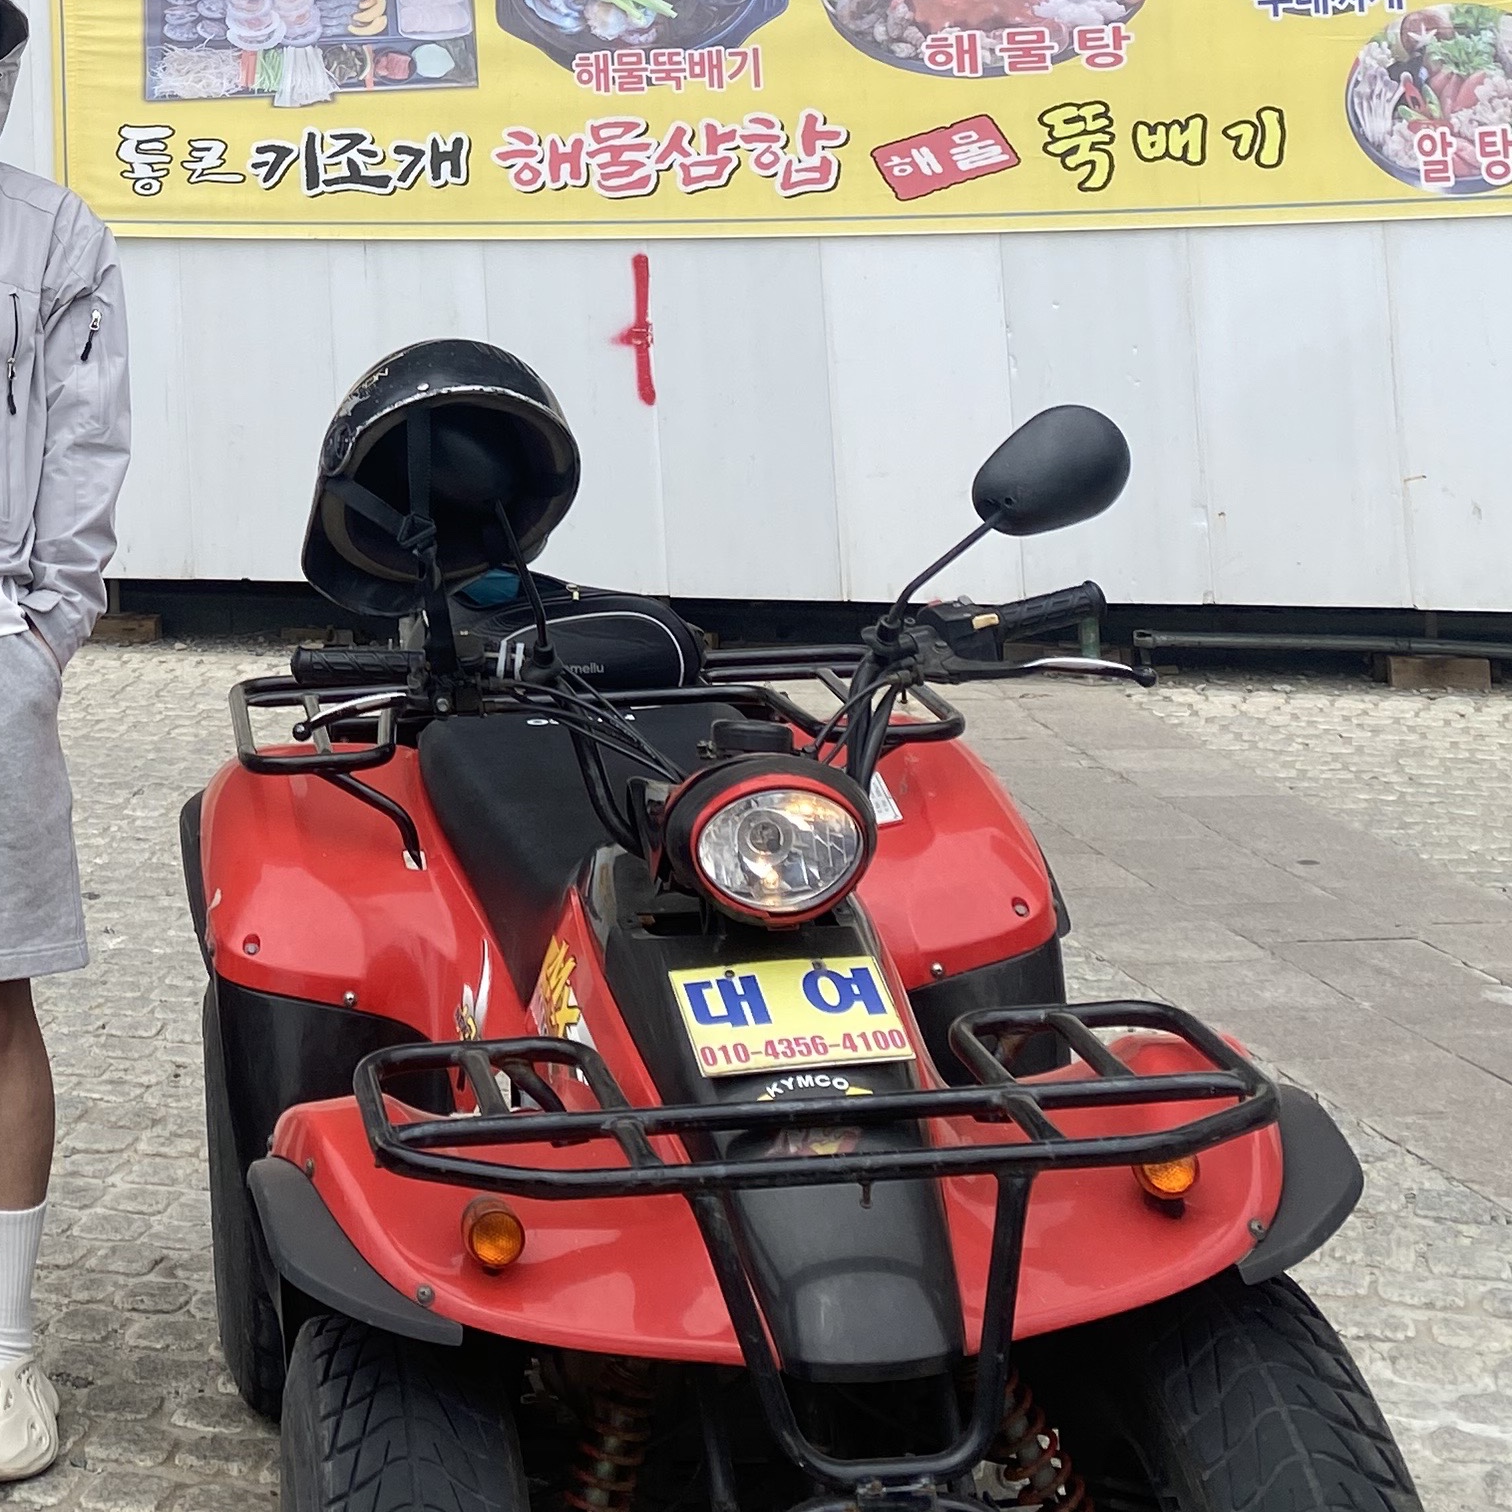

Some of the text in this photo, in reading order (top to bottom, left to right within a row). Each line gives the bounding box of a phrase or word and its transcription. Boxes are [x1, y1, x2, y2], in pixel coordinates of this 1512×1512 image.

[573, 44, 765, 95] 해물뚝배기
[491, 107, 850, 200] 해물삼합
[699, 1029, 907, 1068] 010-4356-4100
[766, 1074, 850, 1098] KYMCO
